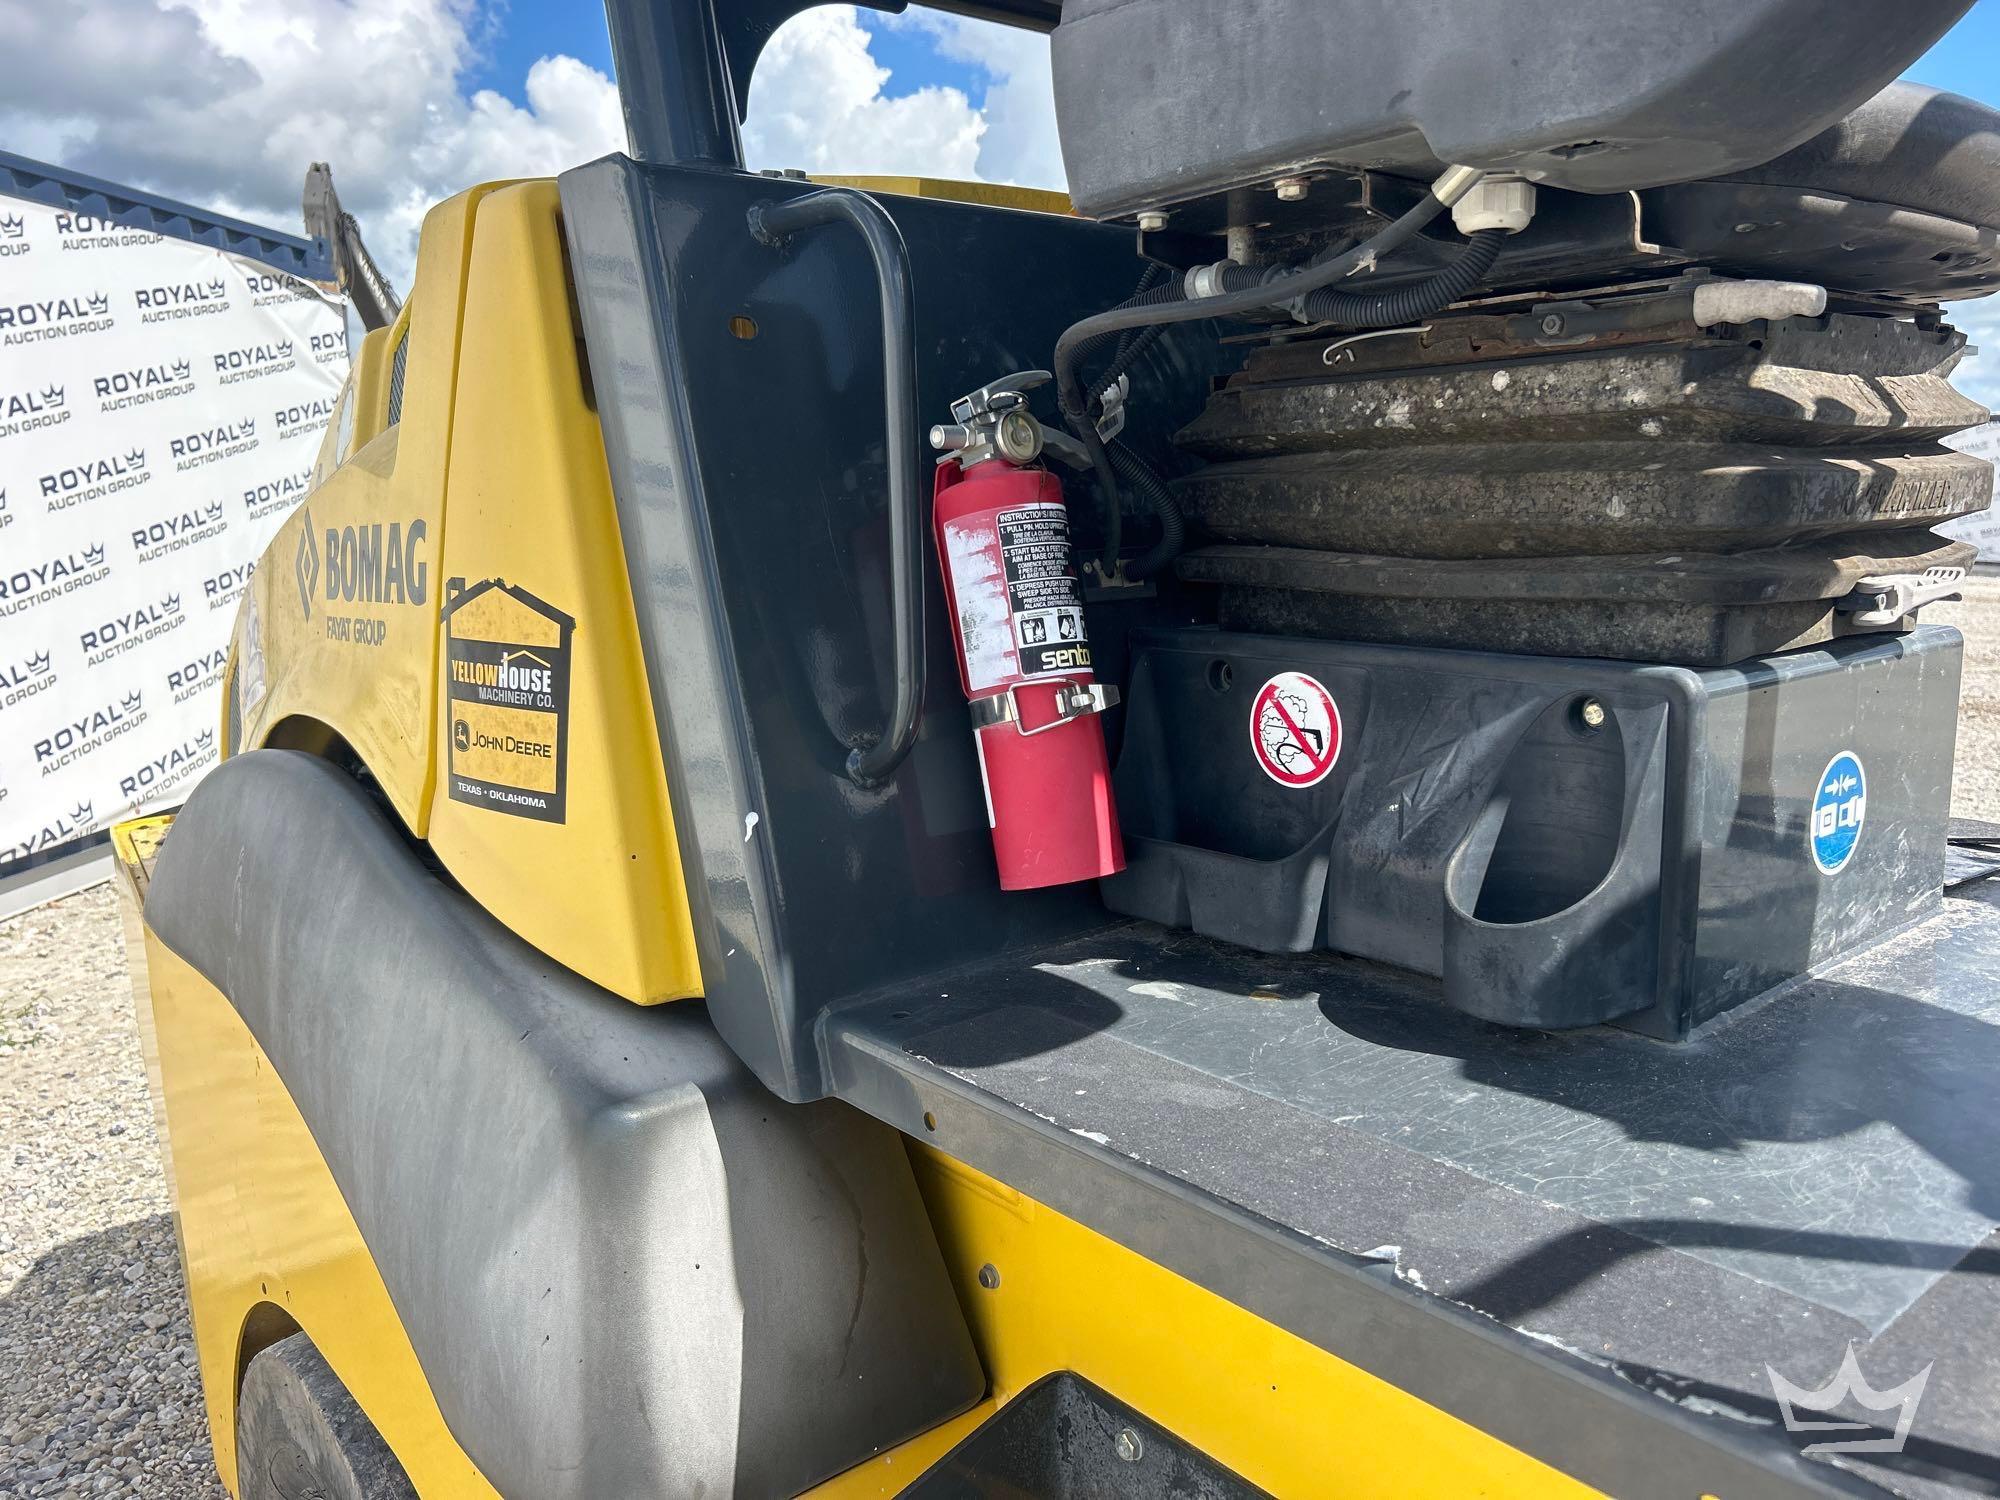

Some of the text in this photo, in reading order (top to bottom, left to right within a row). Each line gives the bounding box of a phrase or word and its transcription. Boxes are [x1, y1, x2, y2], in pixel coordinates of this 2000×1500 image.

[62, 234, 163, 250] AUCTION GROUP
[135, 283, 209, 308] ROYAL
[0, 297, 88, 328] ROYAL
[141, 302, 230, 324] AUCTION GROUP
[4, 319, 114, 346] AUCTION GROUP
[311, 332, 346, 351] ROY
[214, 344, 277, 372] ROYAL
[219, 360, 296, 385] AUCTION GROUP
[94, 366, 173, 397] ROYAL
[101, 383, 195, 413] AUCTION GROUP
[22, 411, 70, 432] GROUP
[275, 399, 332, 428] ROYAL
[170, 425, 240, 458] ROYAL
[279, 421, 319, 440] AUCTION
[177, 438, 260, 473] AUCTION GROUP
[39, 457, 126, 496] ROYAL
[244, 473, 304, 507] ROYAL
[47, 472, 151, 512] AUCTION GROUP
[249, 498, 290, 521] AUCTION
[132, 510, 206, 549] ROYAL
[138, 522, 228, 564] AUCTION GROUP
[1007, 525, 1023, 533] PULL
[326, 519, 427, 607] BOMAG
[1011, 548, 1029, 556] START
[1012, 555, 1024, 563] AIM
[64, 567, 111, 593] GROUP
[204, 562, 256, 598] ROYA
[1017, 583, 1044, 591] DEPRESS
[1017, 590, 1038, 598] SWEEP
[209, 587, 246, 611] AUCTIO
[1024, 596, 1046, 604] PRESIONE
[80, 604, 163, 653] ROYAL
[87, 614, 186, 668] AUCTION GROUP
[327, 616, 386, 646] FAYAT GROUP
[168, 645, 229, 691] ROYA
[5, 674, 57, 706] GROUP
[478, 687, 555, 709] MACHINERY CO.
[34, 704, 123, 763] ROYAL
[41, 712, 148, 778] AUCTION GROUP
[472, 730, 552, 759] JOHN DEERE
[120, 742, 197, 797] ROYAL
[128, 748, 219, 810] AUCTION GROUP
[458, 782, 547, 809] TEXAS OKLAHOMA
